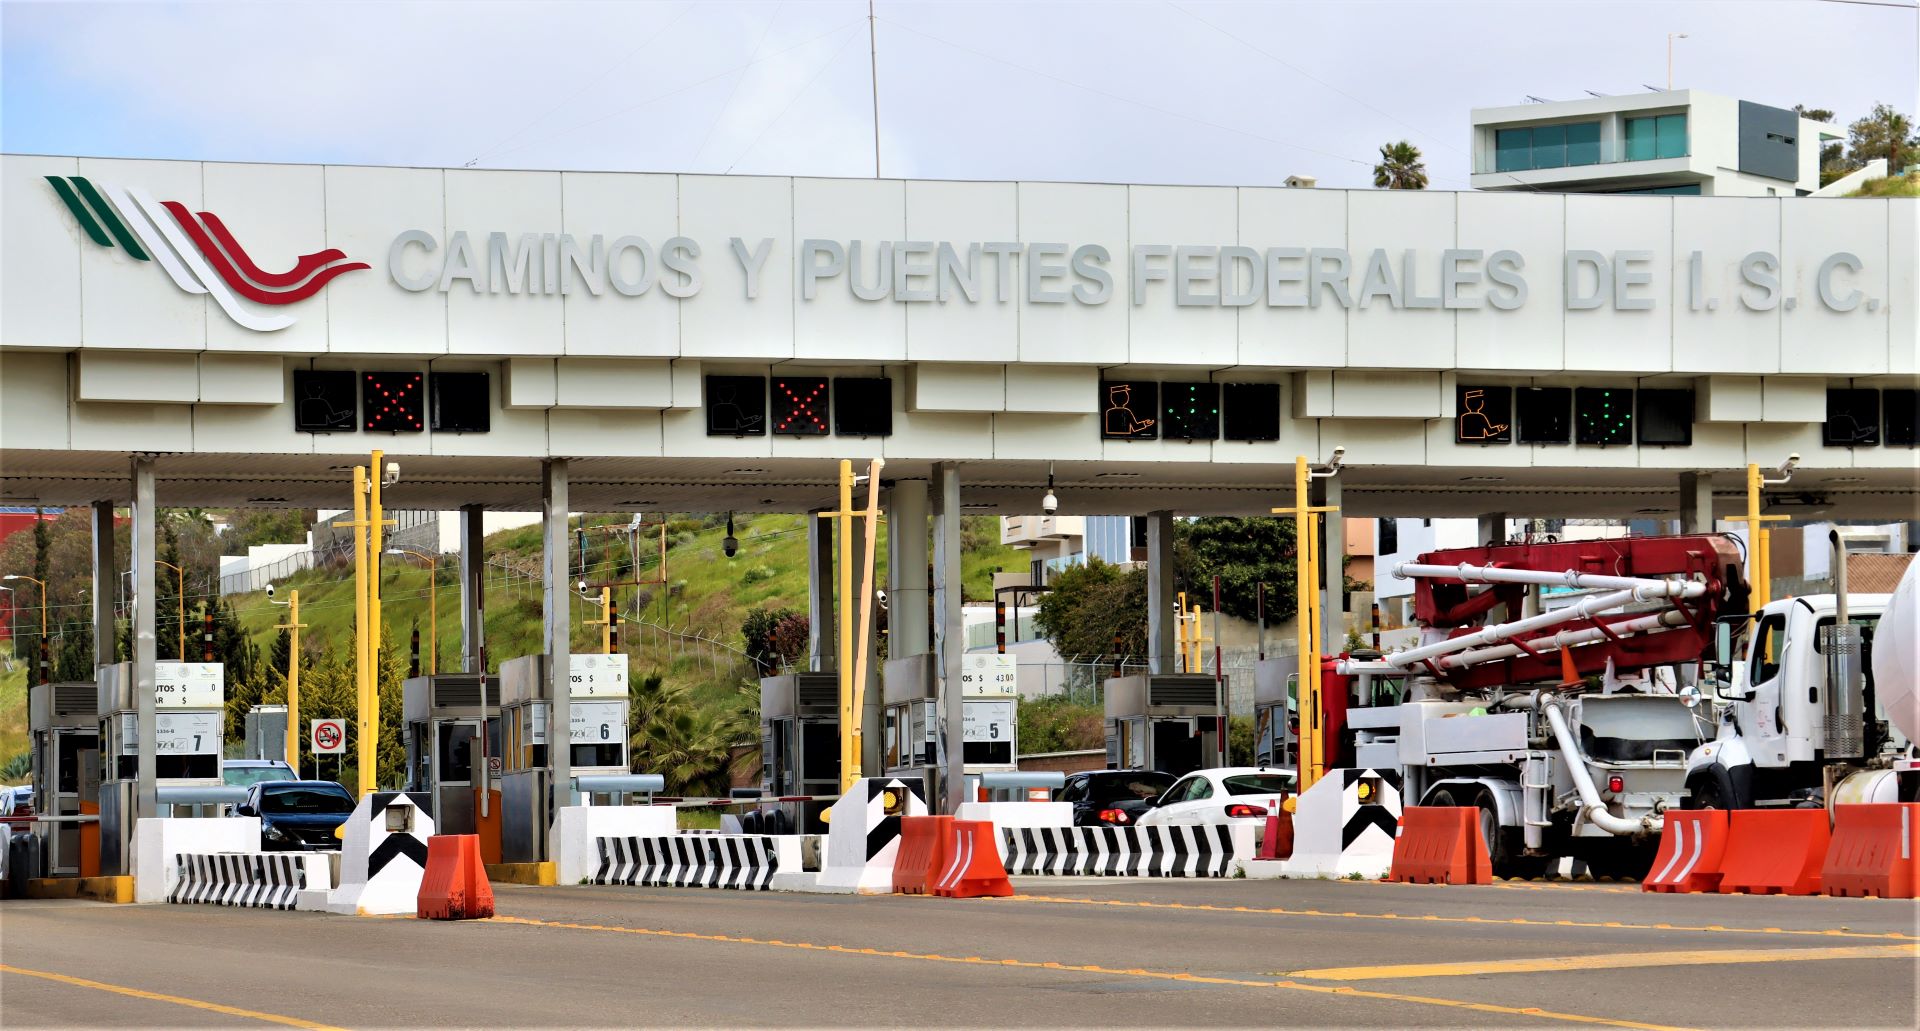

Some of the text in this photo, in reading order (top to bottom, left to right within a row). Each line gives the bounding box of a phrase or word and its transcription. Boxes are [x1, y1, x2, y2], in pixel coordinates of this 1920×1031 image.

[389, 229, 1881, 312] CAMINOS Y PUENTES FEDERALES DE I. S. C.
[617, 674, 621, 682] 0
[600, 723, 610, 740] 6
[990, 723, 999, 739] 5
[193, 735, 202, 752] 7
